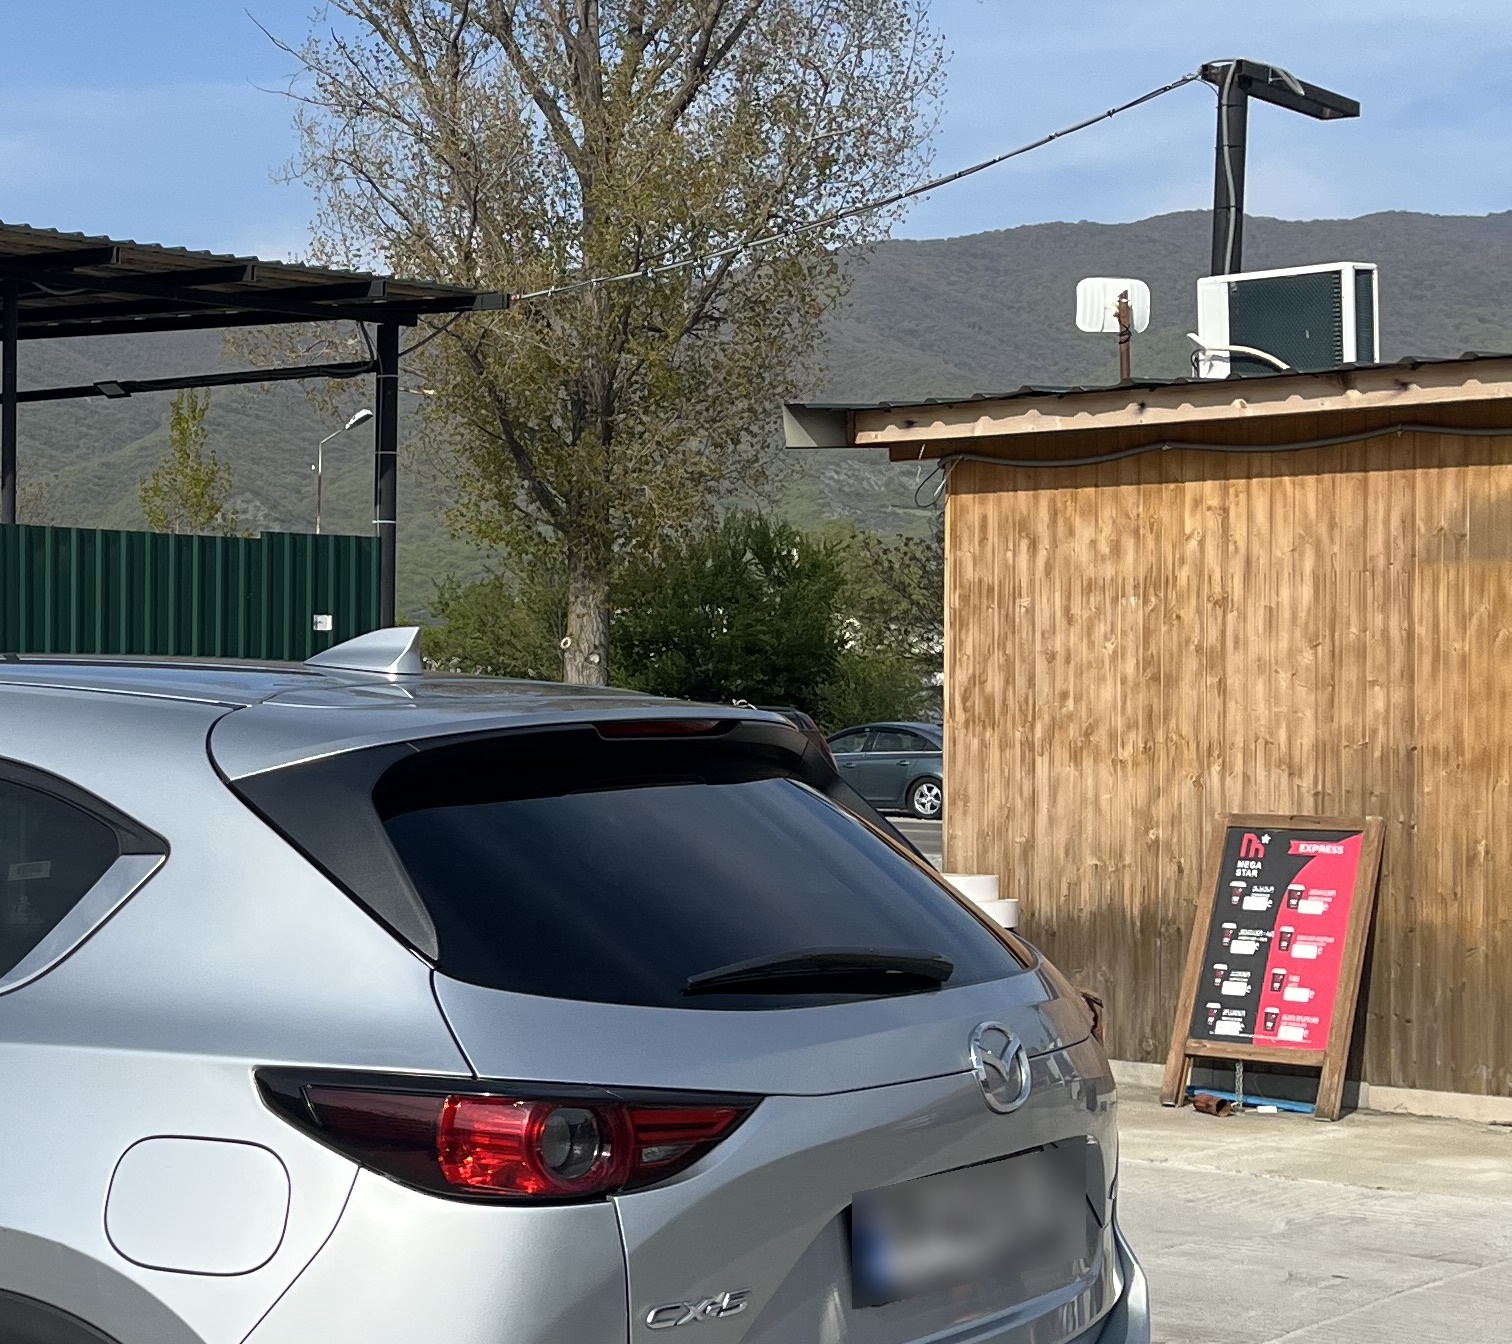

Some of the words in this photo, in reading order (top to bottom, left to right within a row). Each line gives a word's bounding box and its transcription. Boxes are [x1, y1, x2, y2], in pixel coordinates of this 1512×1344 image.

[1299, 843, 1344, 855] EXPRESS
[1236, 860, 1262, 870] MEGA
[1235, 869, 1258, 877] STAR
